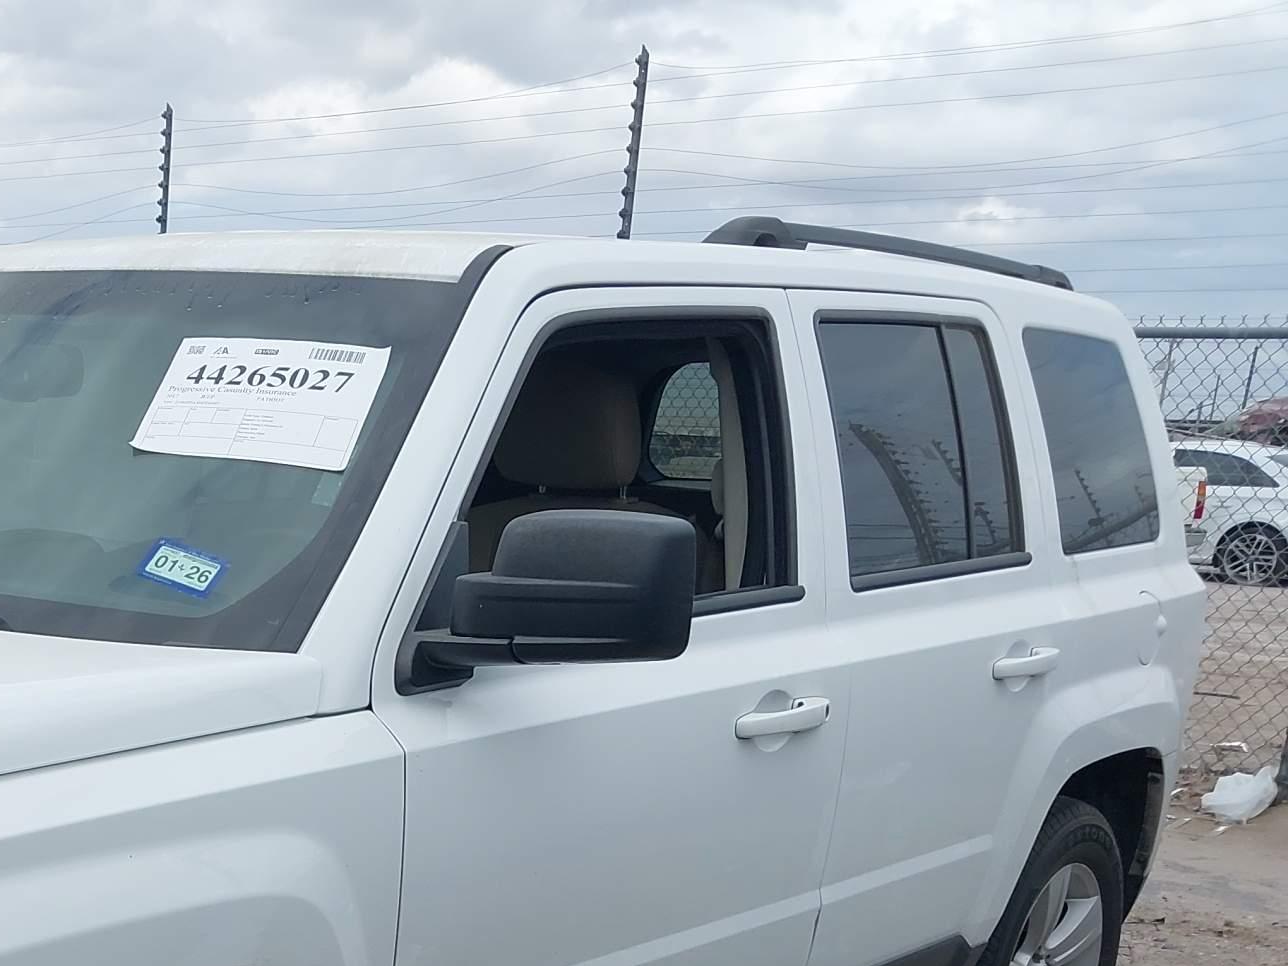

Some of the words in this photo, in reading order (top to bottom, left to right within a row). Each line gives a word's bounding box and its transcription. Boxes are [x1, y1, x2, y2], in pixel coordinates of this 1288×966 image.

[186, 364, 355, 393] 44265027
[168, 386, 215, 394] Progressive
[217, 387, 253, 396] Casualty
[255, 388, 297, 397] Insurance
